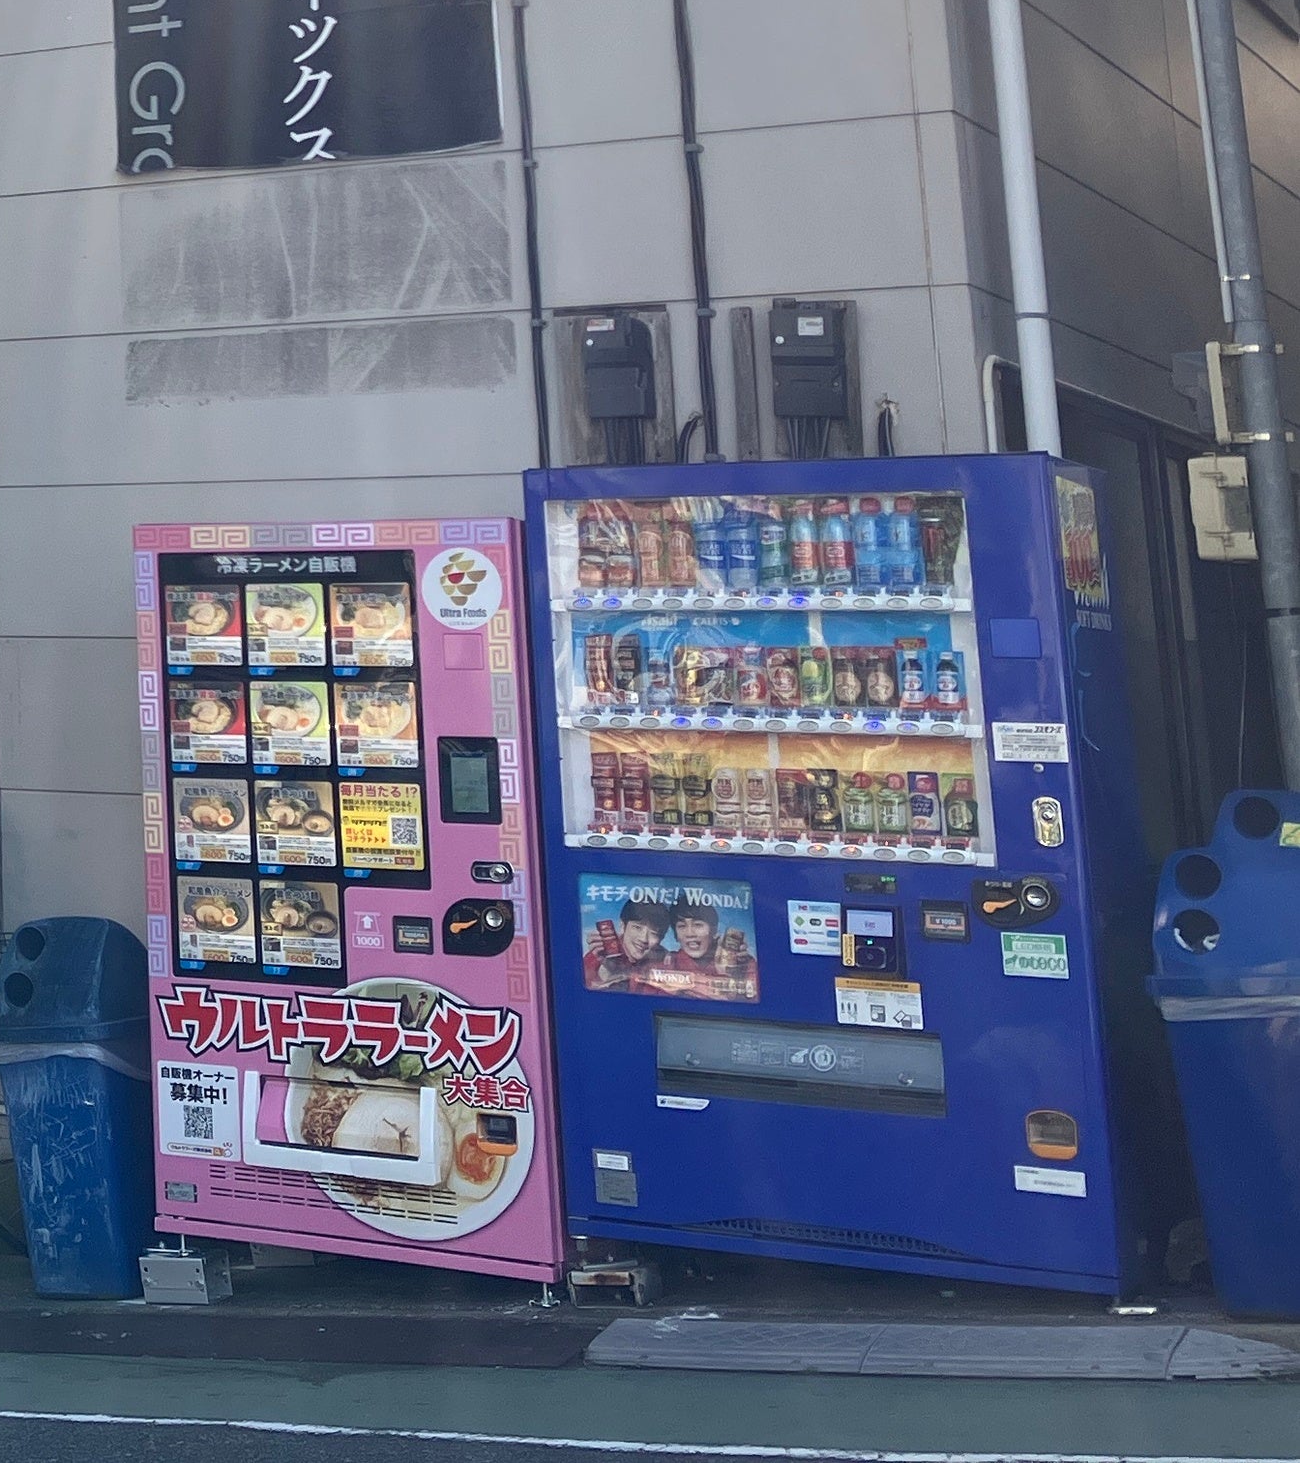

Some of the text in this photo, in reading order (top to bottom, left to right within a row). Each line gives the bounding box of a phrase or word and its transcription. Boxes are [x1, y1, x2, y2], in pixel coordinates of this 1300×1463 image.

[683, 886, 750, 910] WONDA!
[356, 936, 381, 947] 1000
[156, 984, 522, 1073] ウルトララーメン
[161, 1066, 236, 1083] 自販機オーナー
[441, 1072, 531, 1113] 大集合
